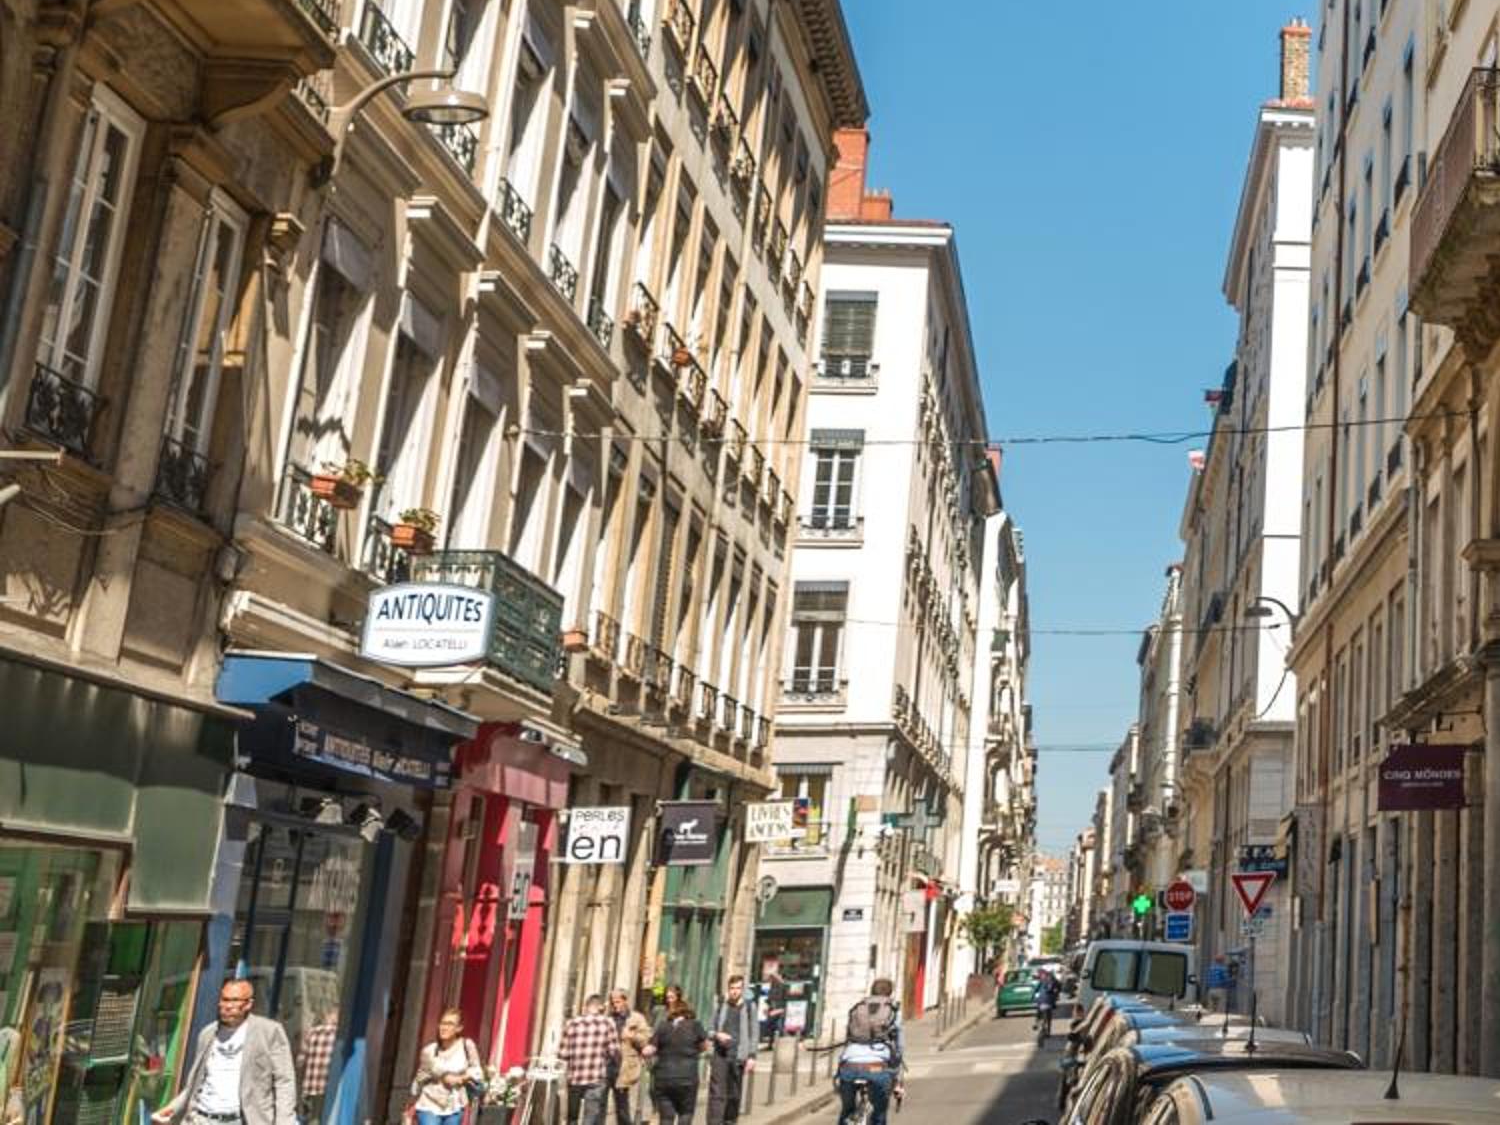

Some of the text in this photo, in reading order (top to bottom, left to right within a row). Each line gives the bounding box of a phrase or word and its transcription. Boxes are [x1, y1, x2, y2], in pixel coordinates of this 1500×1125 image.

[376, 593, 483, 625] ANTIQUITES
[571, 834, 621, 860] en
[1167, 890, 1193, 903] STOP
